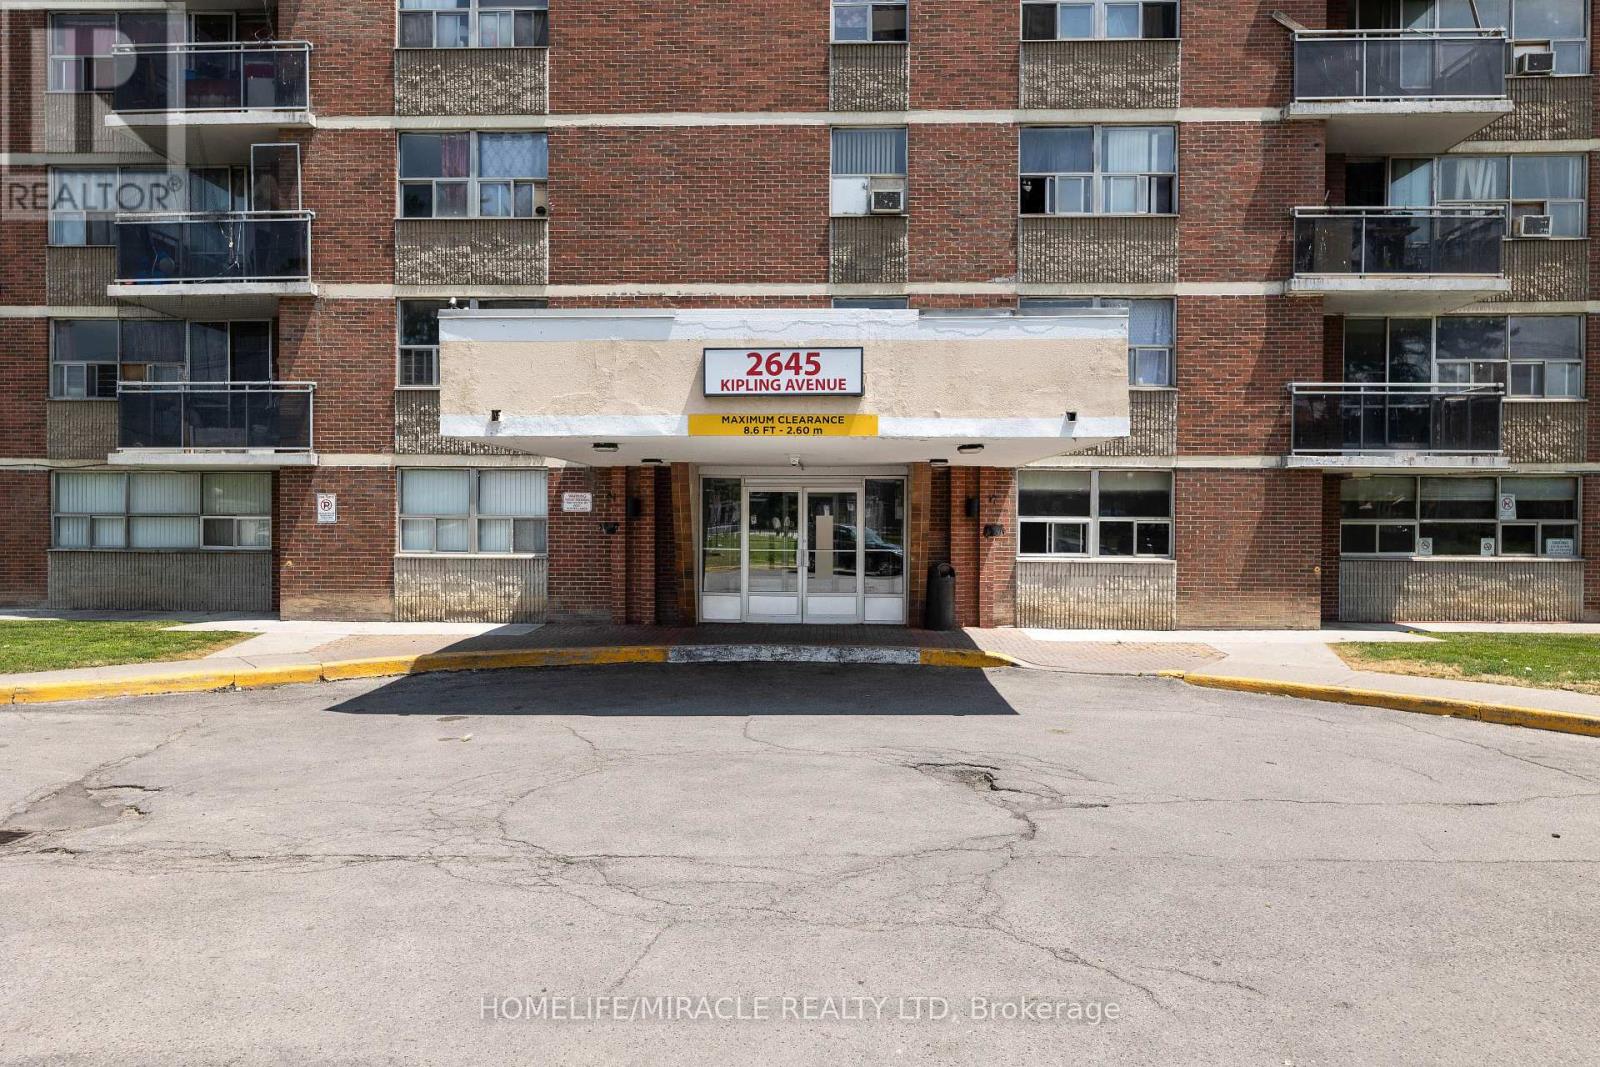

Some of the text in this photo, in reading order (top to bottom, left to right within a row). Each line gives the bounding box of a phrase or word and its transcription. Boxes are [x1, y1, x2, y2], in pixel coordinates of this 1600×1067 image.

[746, 352, 821, 376] 2645
[720, 378, 847, 391] KIPLING AVENUE
[721, 415, 845, 424] MAXIMUM CLEARANCE
[743, 426, 760, 435] 8.6
[763, 426, 776, 435] FT
[786, 426, 810, 435] 2.60
